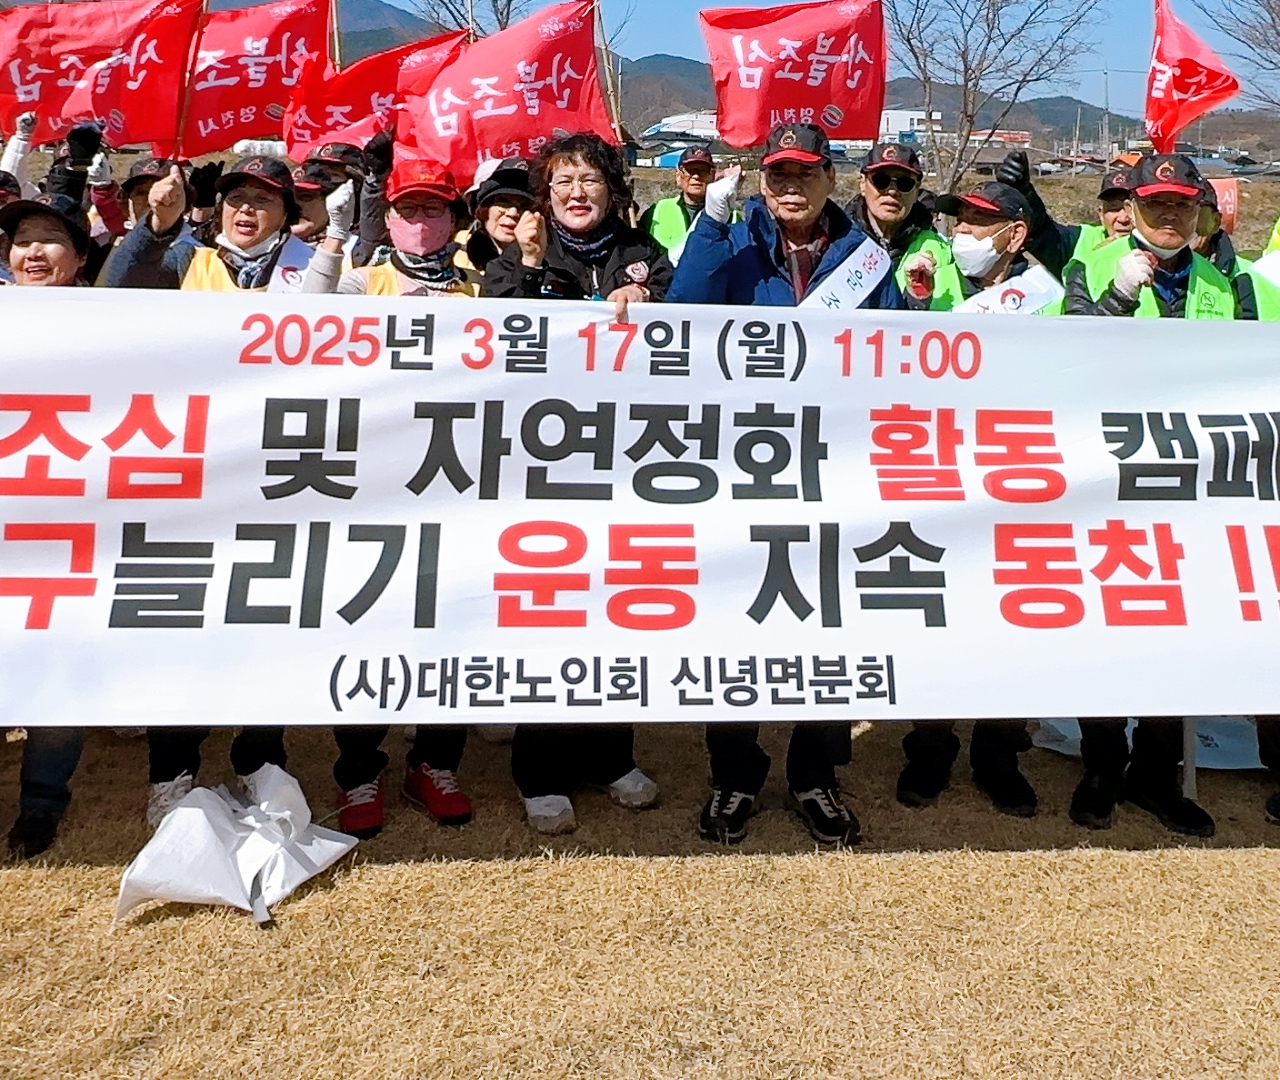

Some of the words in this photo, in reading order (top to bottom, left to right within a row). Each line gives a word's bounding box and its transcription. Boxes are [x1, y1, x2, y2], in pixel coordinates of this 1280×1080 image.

[238, 313, 435, 371] 2025년
[461, 314, 549, 374] 3월
[578, 320, 691, 377] 17일
[717, 319, 808, 382] (월)
[834, 328, 982, 380] 11:00
[259, 397, 361, 501] 및
[404, 398, 829, 505] 자연정화
[869, 403, 1067, 504] 활동
[493, 520, 699, 631] 운동
[745, 521, 947, 628] 지속
[993, 519, 1187, 629] 동참
[329, 654, 649, 712] (사)대한노인회
[670, 654, 897, 707] 신녕면분회
